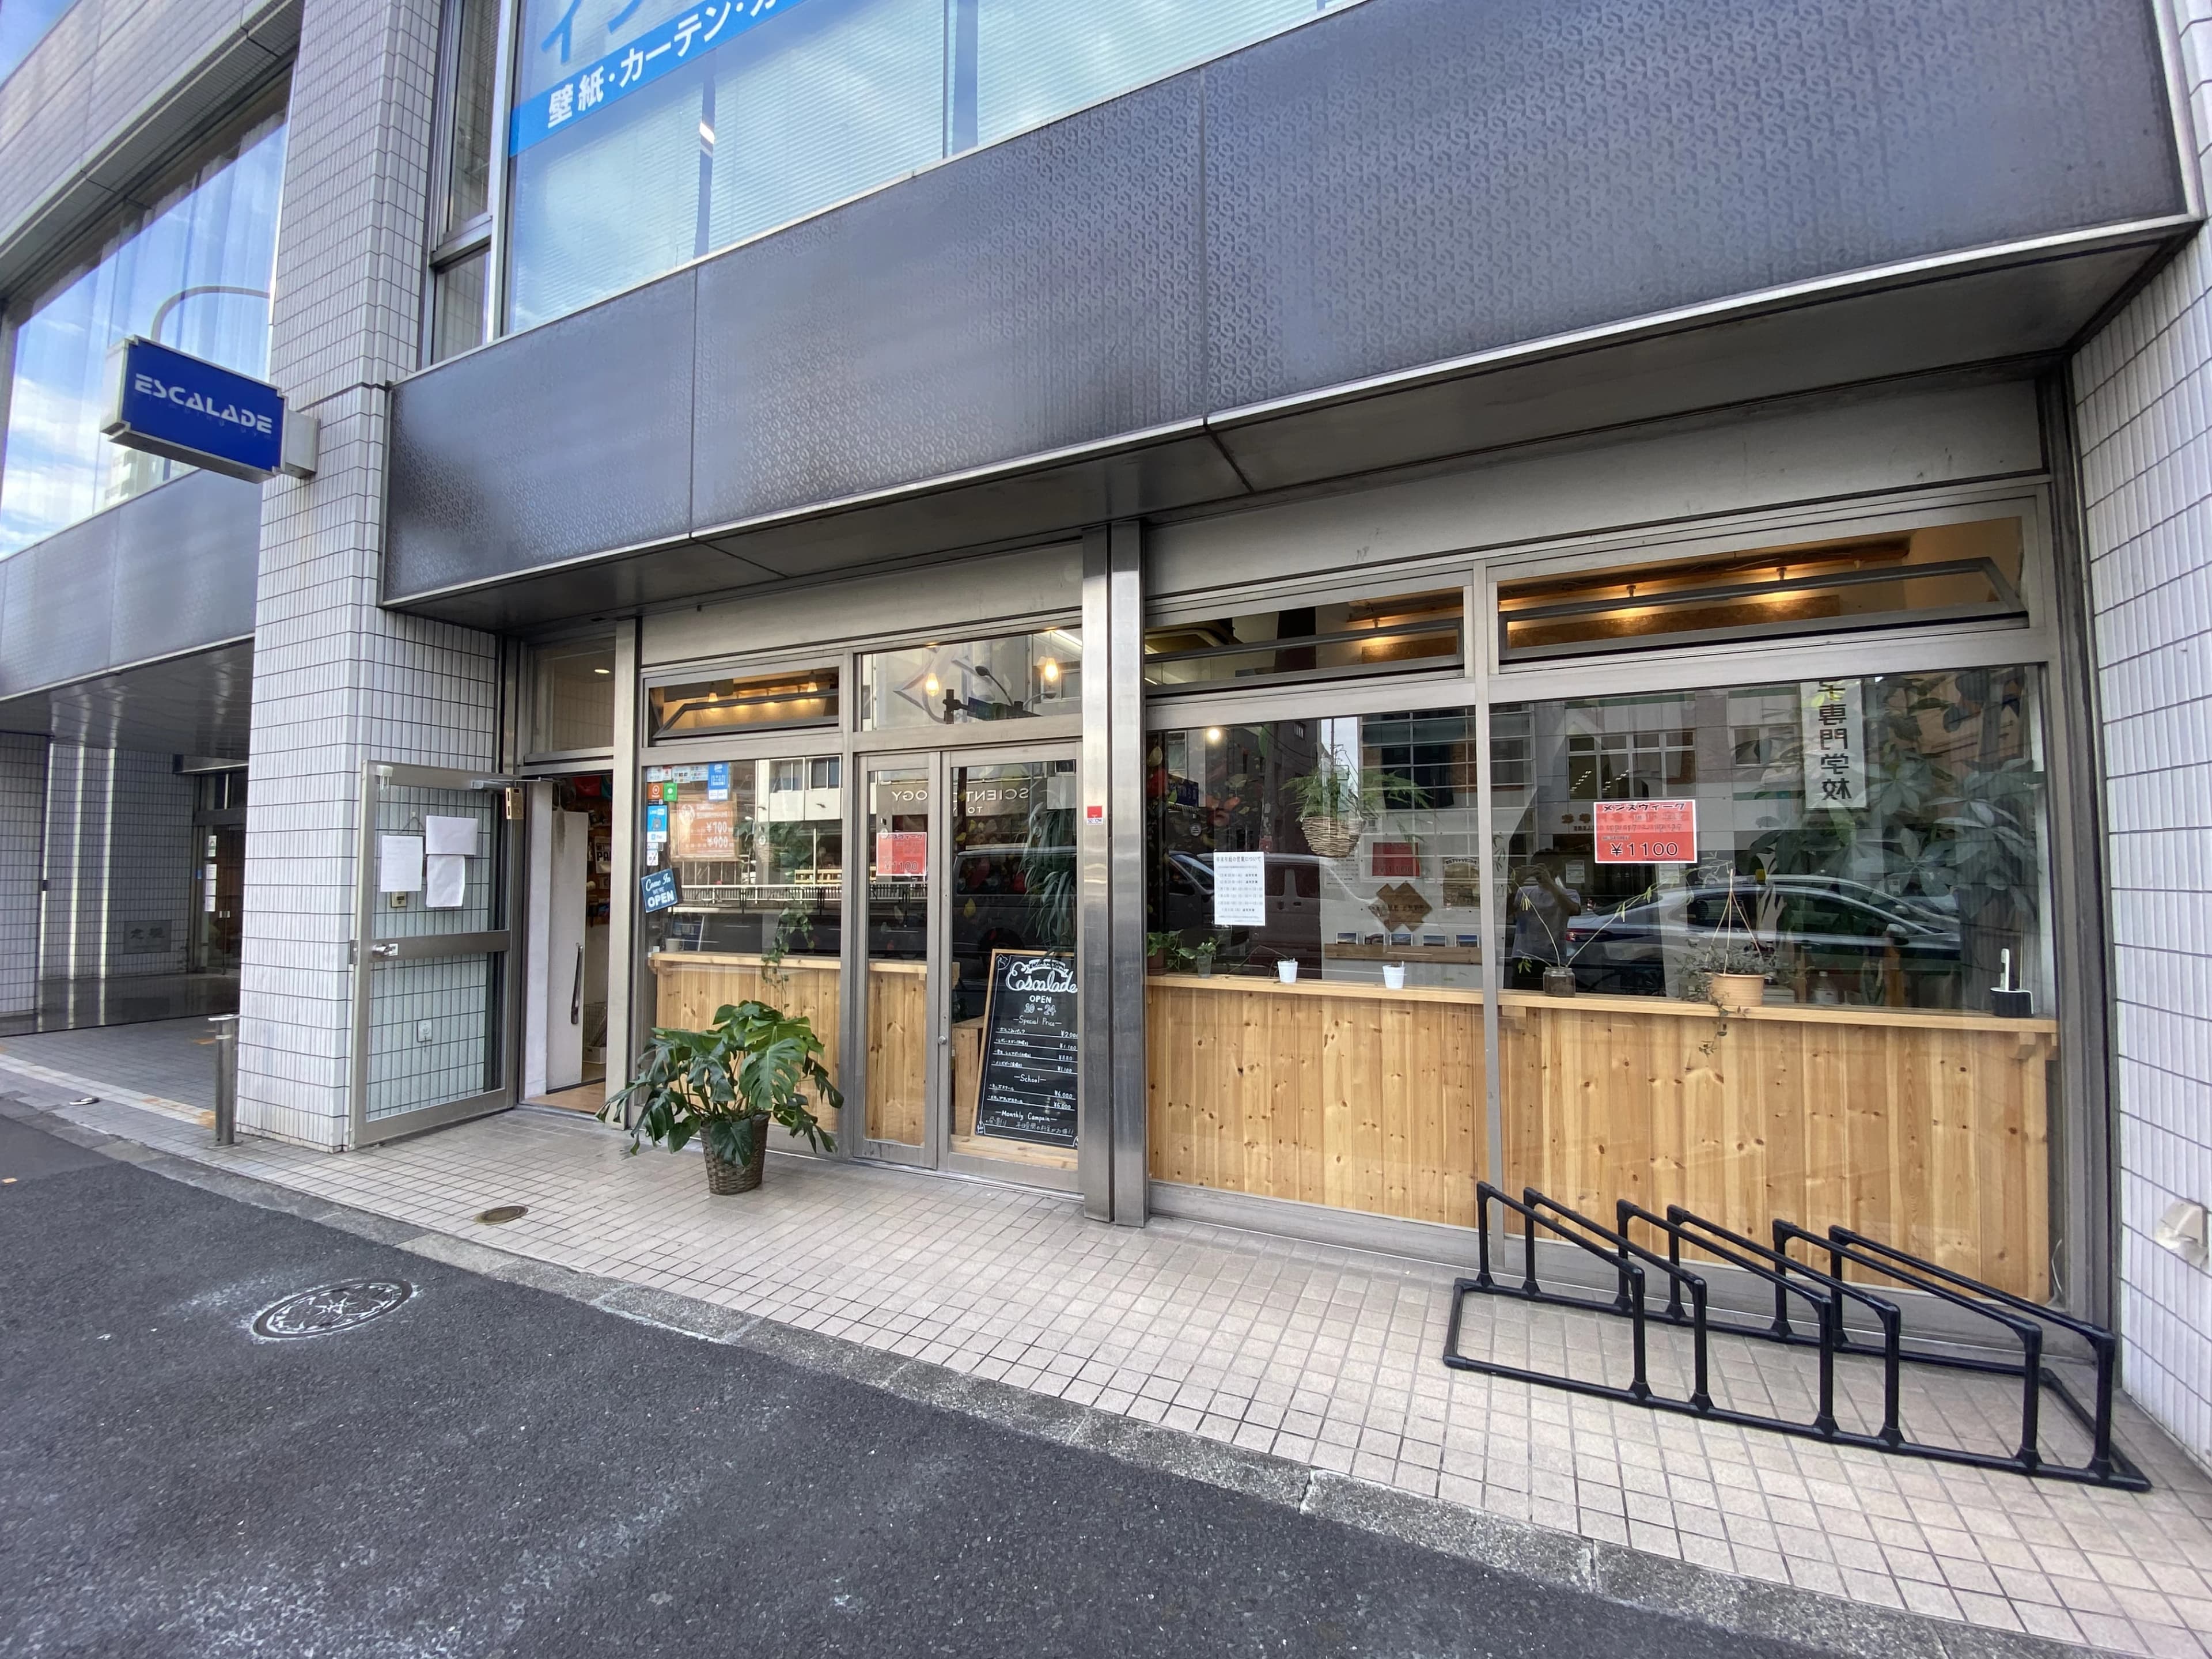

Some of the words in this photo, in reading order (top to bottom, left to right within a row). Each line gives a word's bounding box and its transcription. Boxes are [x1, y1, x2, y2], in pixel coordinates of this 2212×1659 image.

[135, 373, 272, 434] ESCALADE
[1611, 842, 1679, 857] ¥1100
[646, 878, 661, 892] Come
[662, 873, 671, 885] In
[647, 889, 675, 908] OPEN
[1029, 995, 1052, 1003] OPEN
